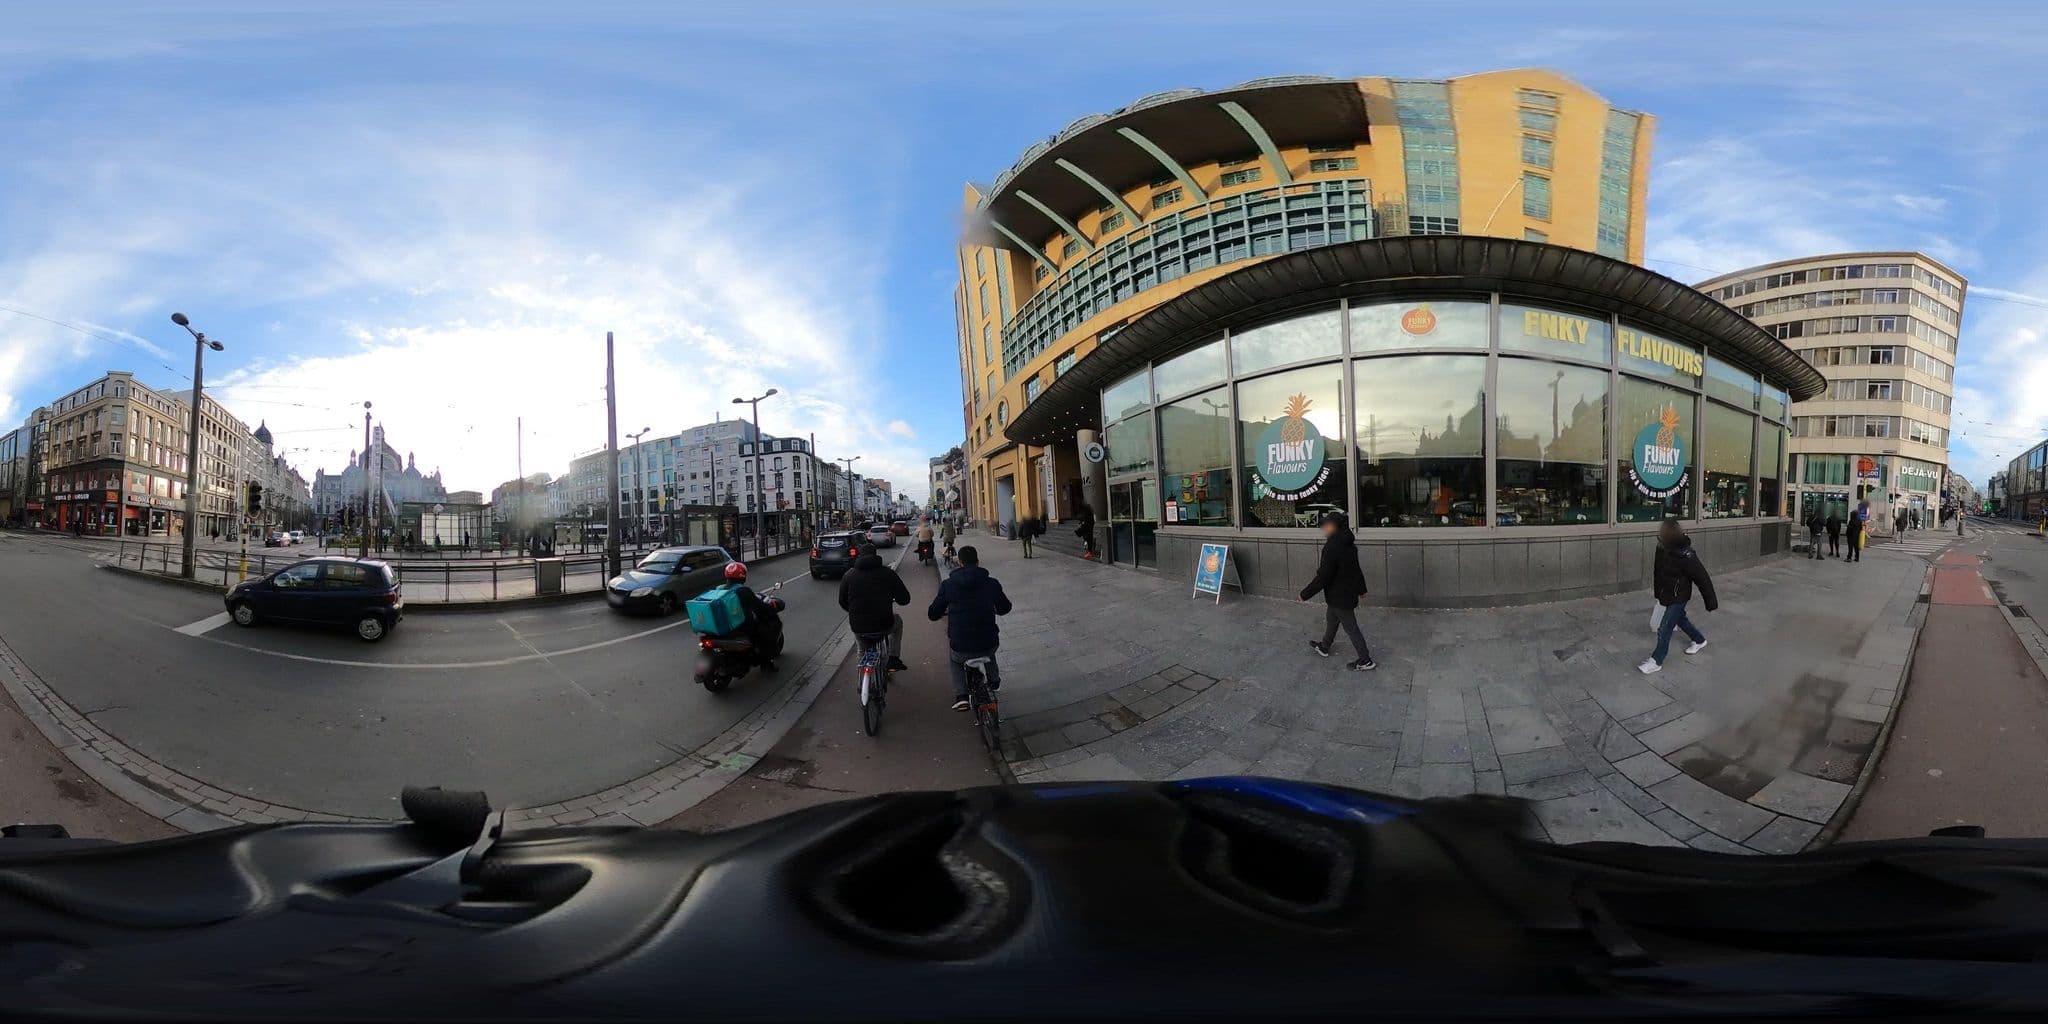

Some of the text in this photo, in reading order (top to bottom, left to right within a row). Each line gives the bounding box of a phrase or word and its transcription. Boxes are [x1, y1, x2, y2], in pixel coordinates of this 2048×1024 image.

[1617, 328, 1703, 377] FLAVOURS
[1268, 439, 1315, 463] FUNKY
[1644, 444, 1680, 466] FUNKY
[1266, 461, 1308, 475] Flavours
[1642, 462, 1674, 475] Flavours
